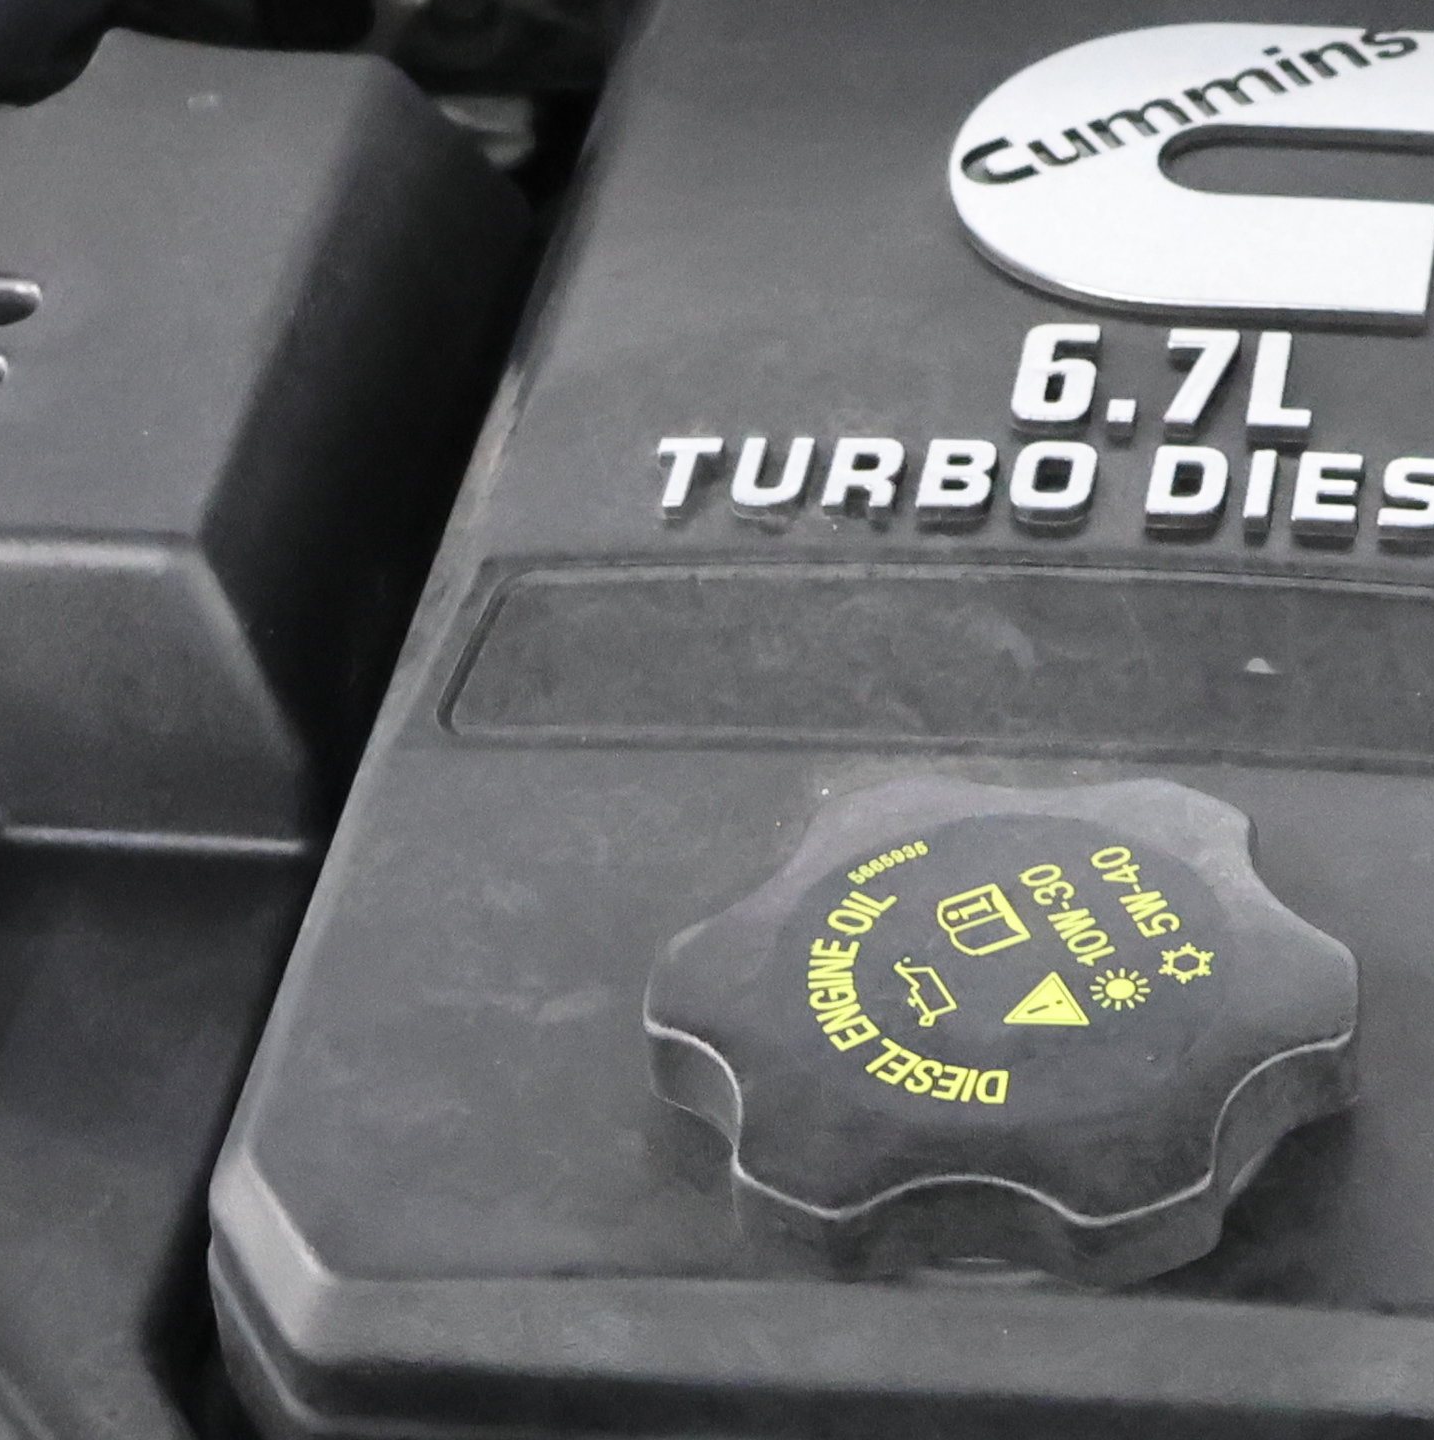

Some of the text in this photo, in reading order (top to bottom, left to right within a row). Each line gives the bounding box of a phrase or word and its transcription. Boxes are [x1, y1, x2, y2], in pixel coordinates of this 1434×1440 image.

[1010, 324, 1314, 432] 6.7L
[658, 437, 1099, 522] TURBO
[1017, 863, 1117, 966] 10W-30
[1090, 845, 1181, 938] 5W-40
[808, 890, 1010, 1104] DIESEL ENGINE OIL
